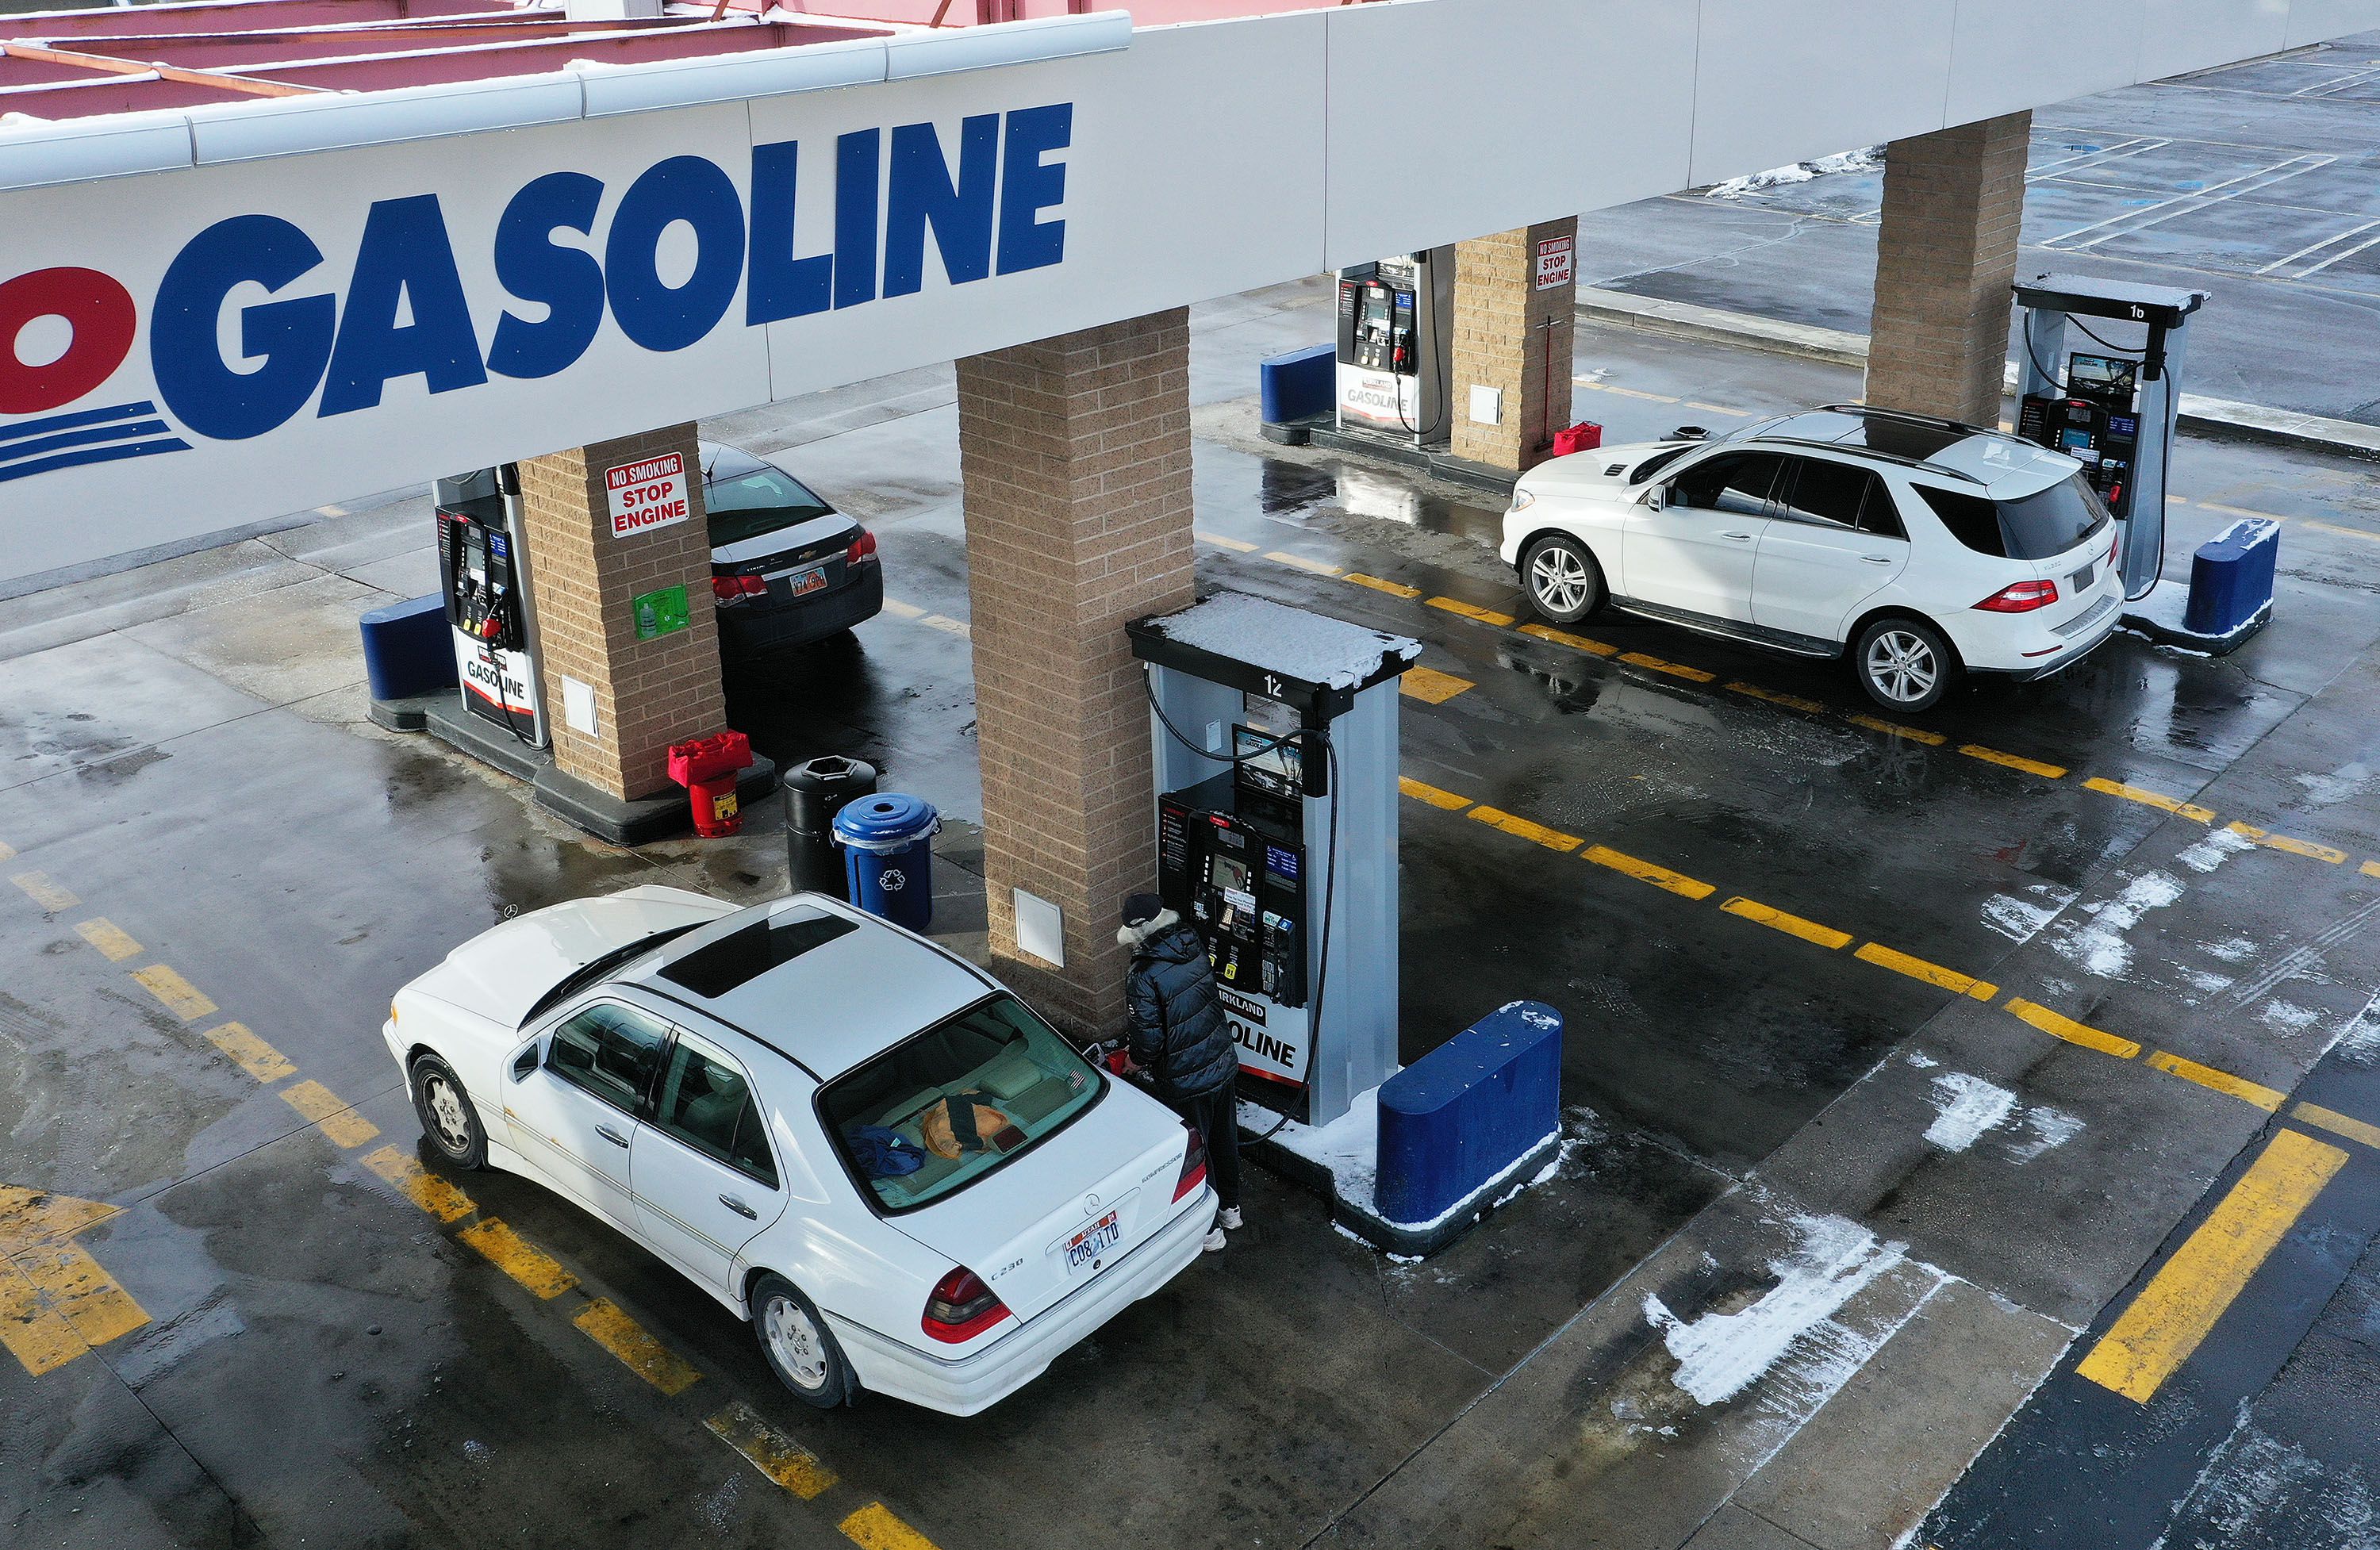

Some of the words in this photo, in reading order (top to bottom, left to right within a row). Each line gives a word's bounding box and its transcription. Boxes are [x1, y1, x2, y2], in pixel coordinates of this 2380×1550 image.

[1539, 244, 1548, 255] NO
[1548, 239, 1570, 253] SMOKING
[150, 102, 1073, 440] GASOLINE
[1543, 255, 1566, 270] STOP
[1537, 268, 1570, 286] ENGINE
[1347, 389, 1408, 412] GASOLINE
[611, 470, 627, 487] NO
[629, 457, 678, 483] SMOKING
[623, 481, 673, 508] STOP
[614, 499, 686, 532] ENGINE
[467, 661, 524, 700] GASOINE
[1219, 989, 1264, 1017] IRKLAND
[1227, 1020, 1296, 1069] OLINE
[1142, 1152, 1183, 1184] KOMPRESSOR
[1081, 1221, 1100, 1238] UTAH
